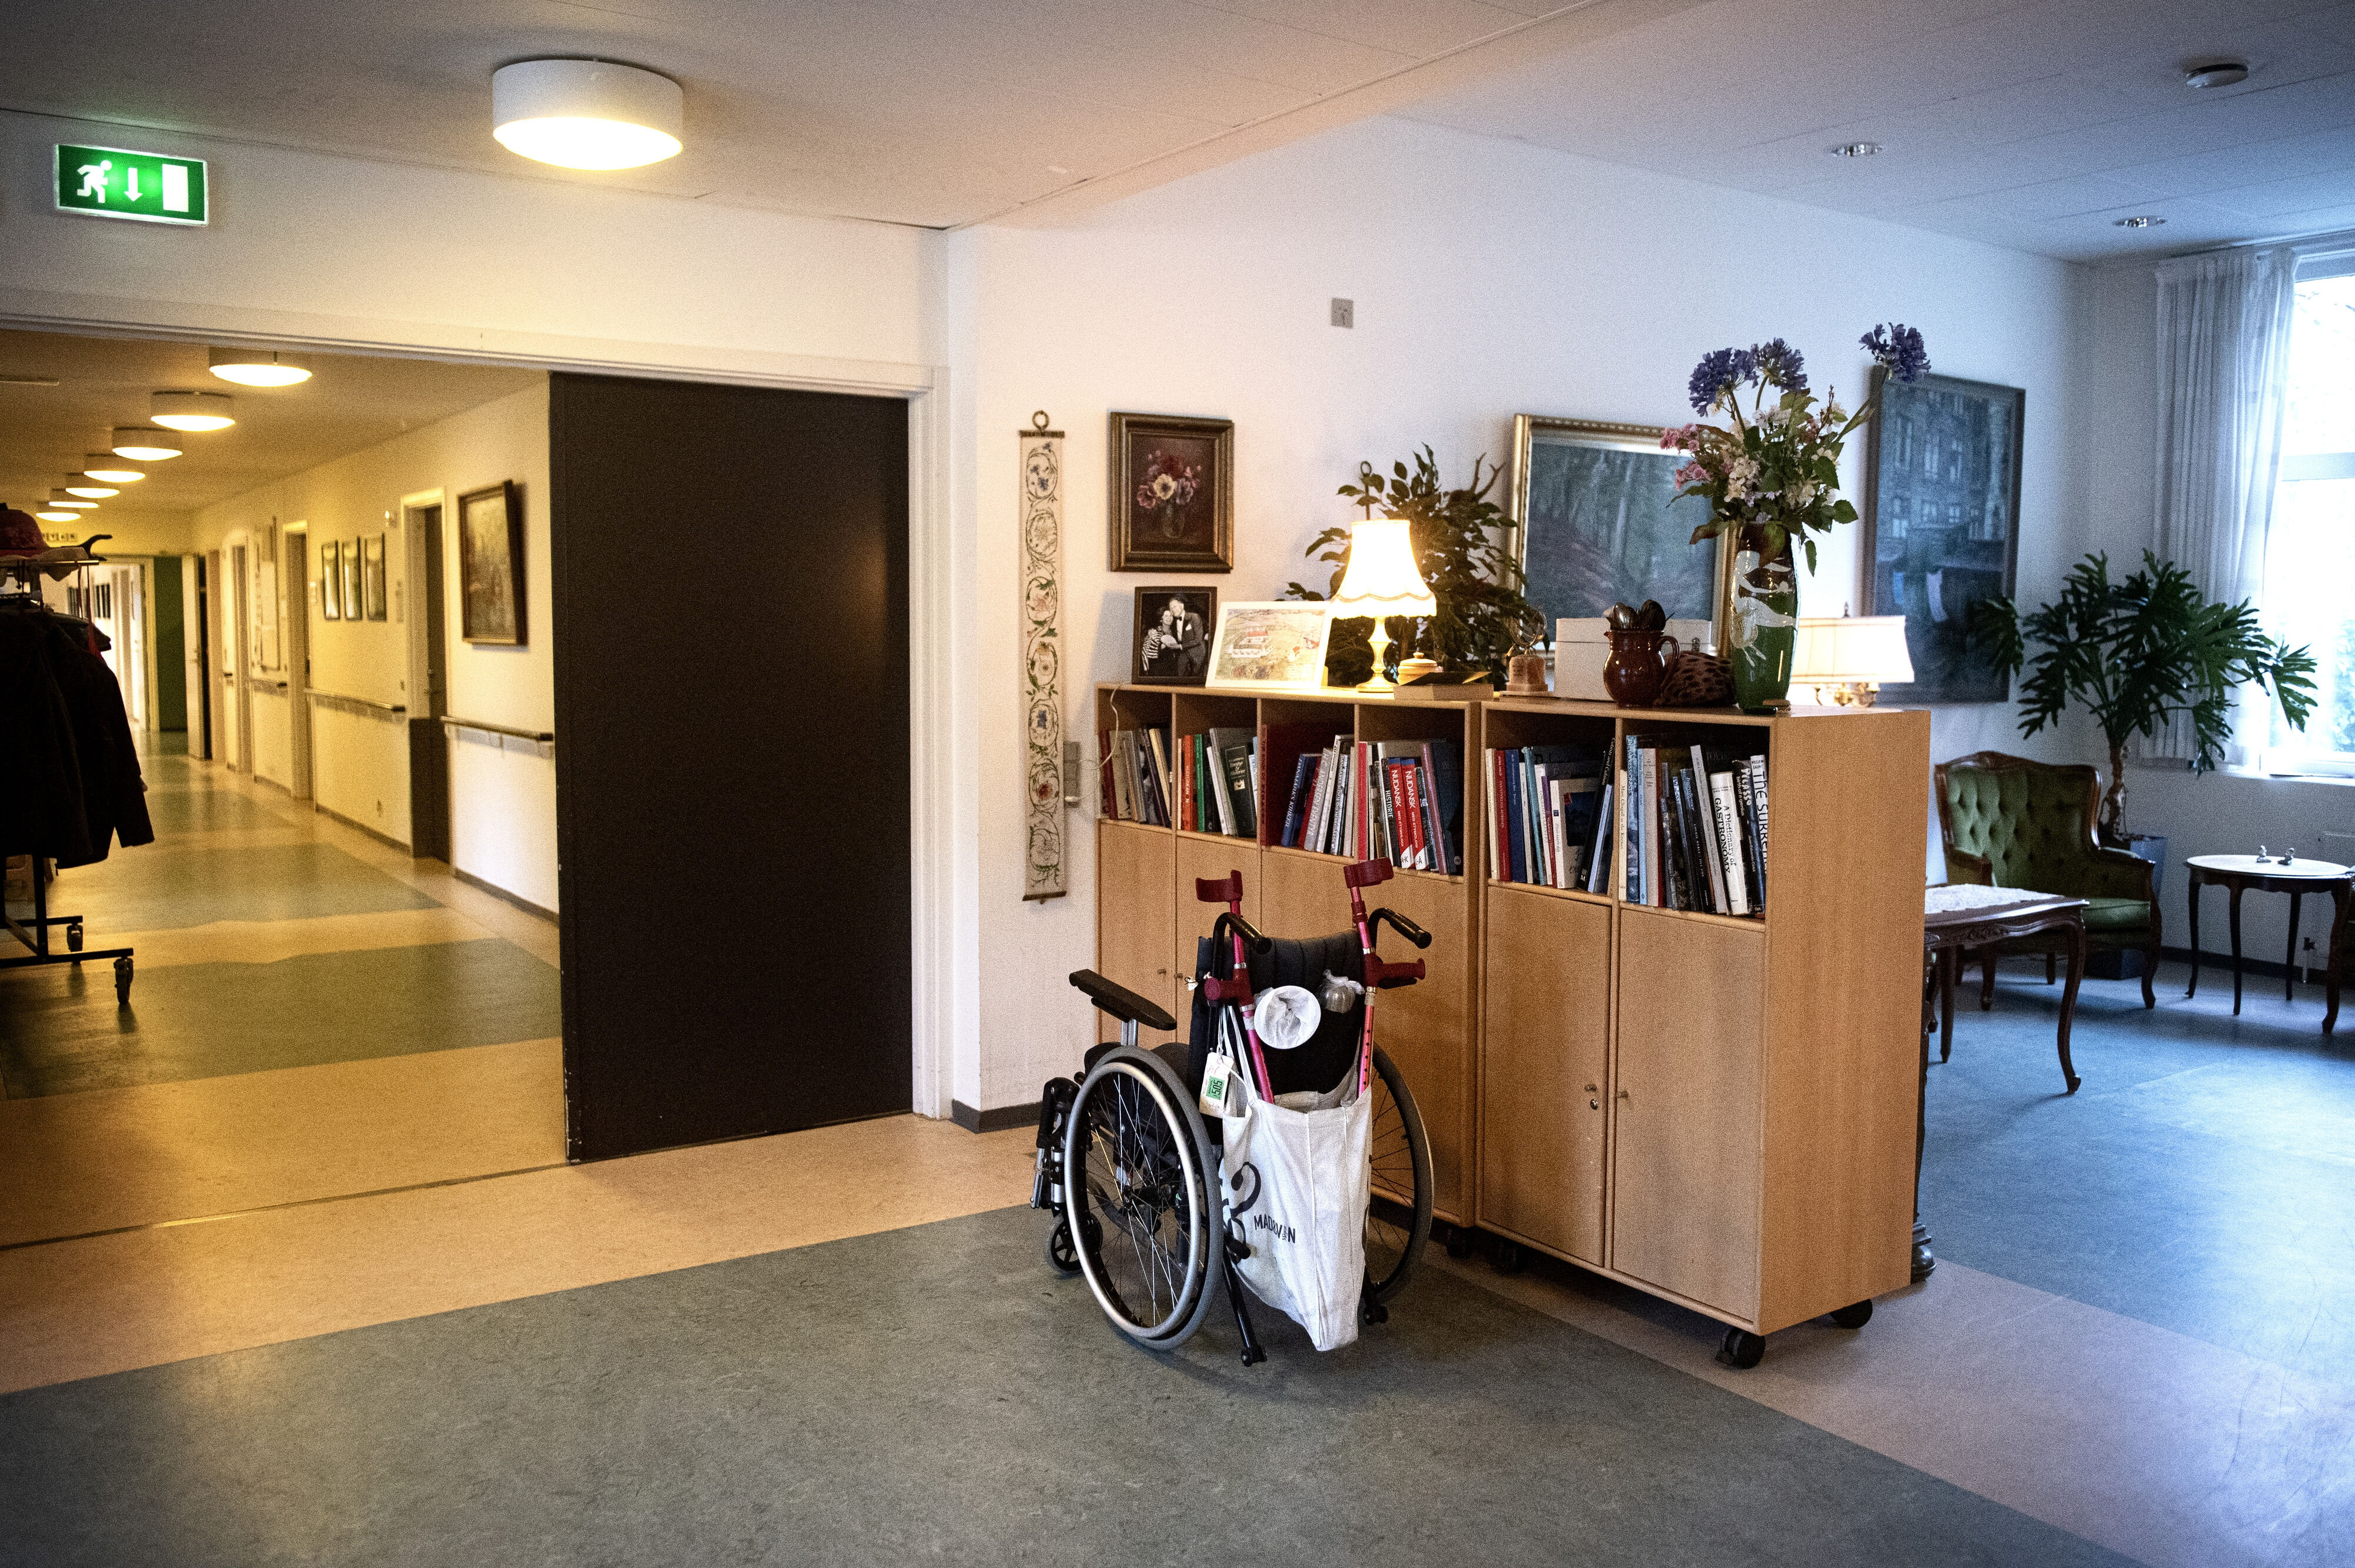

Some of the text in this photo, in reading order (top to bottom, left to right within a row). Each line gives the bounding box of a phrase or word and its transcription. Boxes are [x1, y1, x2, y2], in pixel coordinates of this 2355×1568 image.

[1606, 738, 1616, 756] Cubists
[1285, 758, 1303, 828] DANMARKS KIRKER
[1313, 768, 1324, 806] ANDERSEN
[1391, 770, 1401, 808] NUDANSK
[1405, 771, 1415, 809] NUDANSK
[1601, 766, 1610, 785] Cubism
[1307, 806, 1319, 836] EVENTYR
[1385, 790, 1393, 818] HISTORIE
[1714, 798, 1730, 873] GASTRONOMY
[1724, 813, 1734, 856] Dictionary
[1730, 858, 1737, 866] of
[1212, 1079, 1223, 1095] 505
